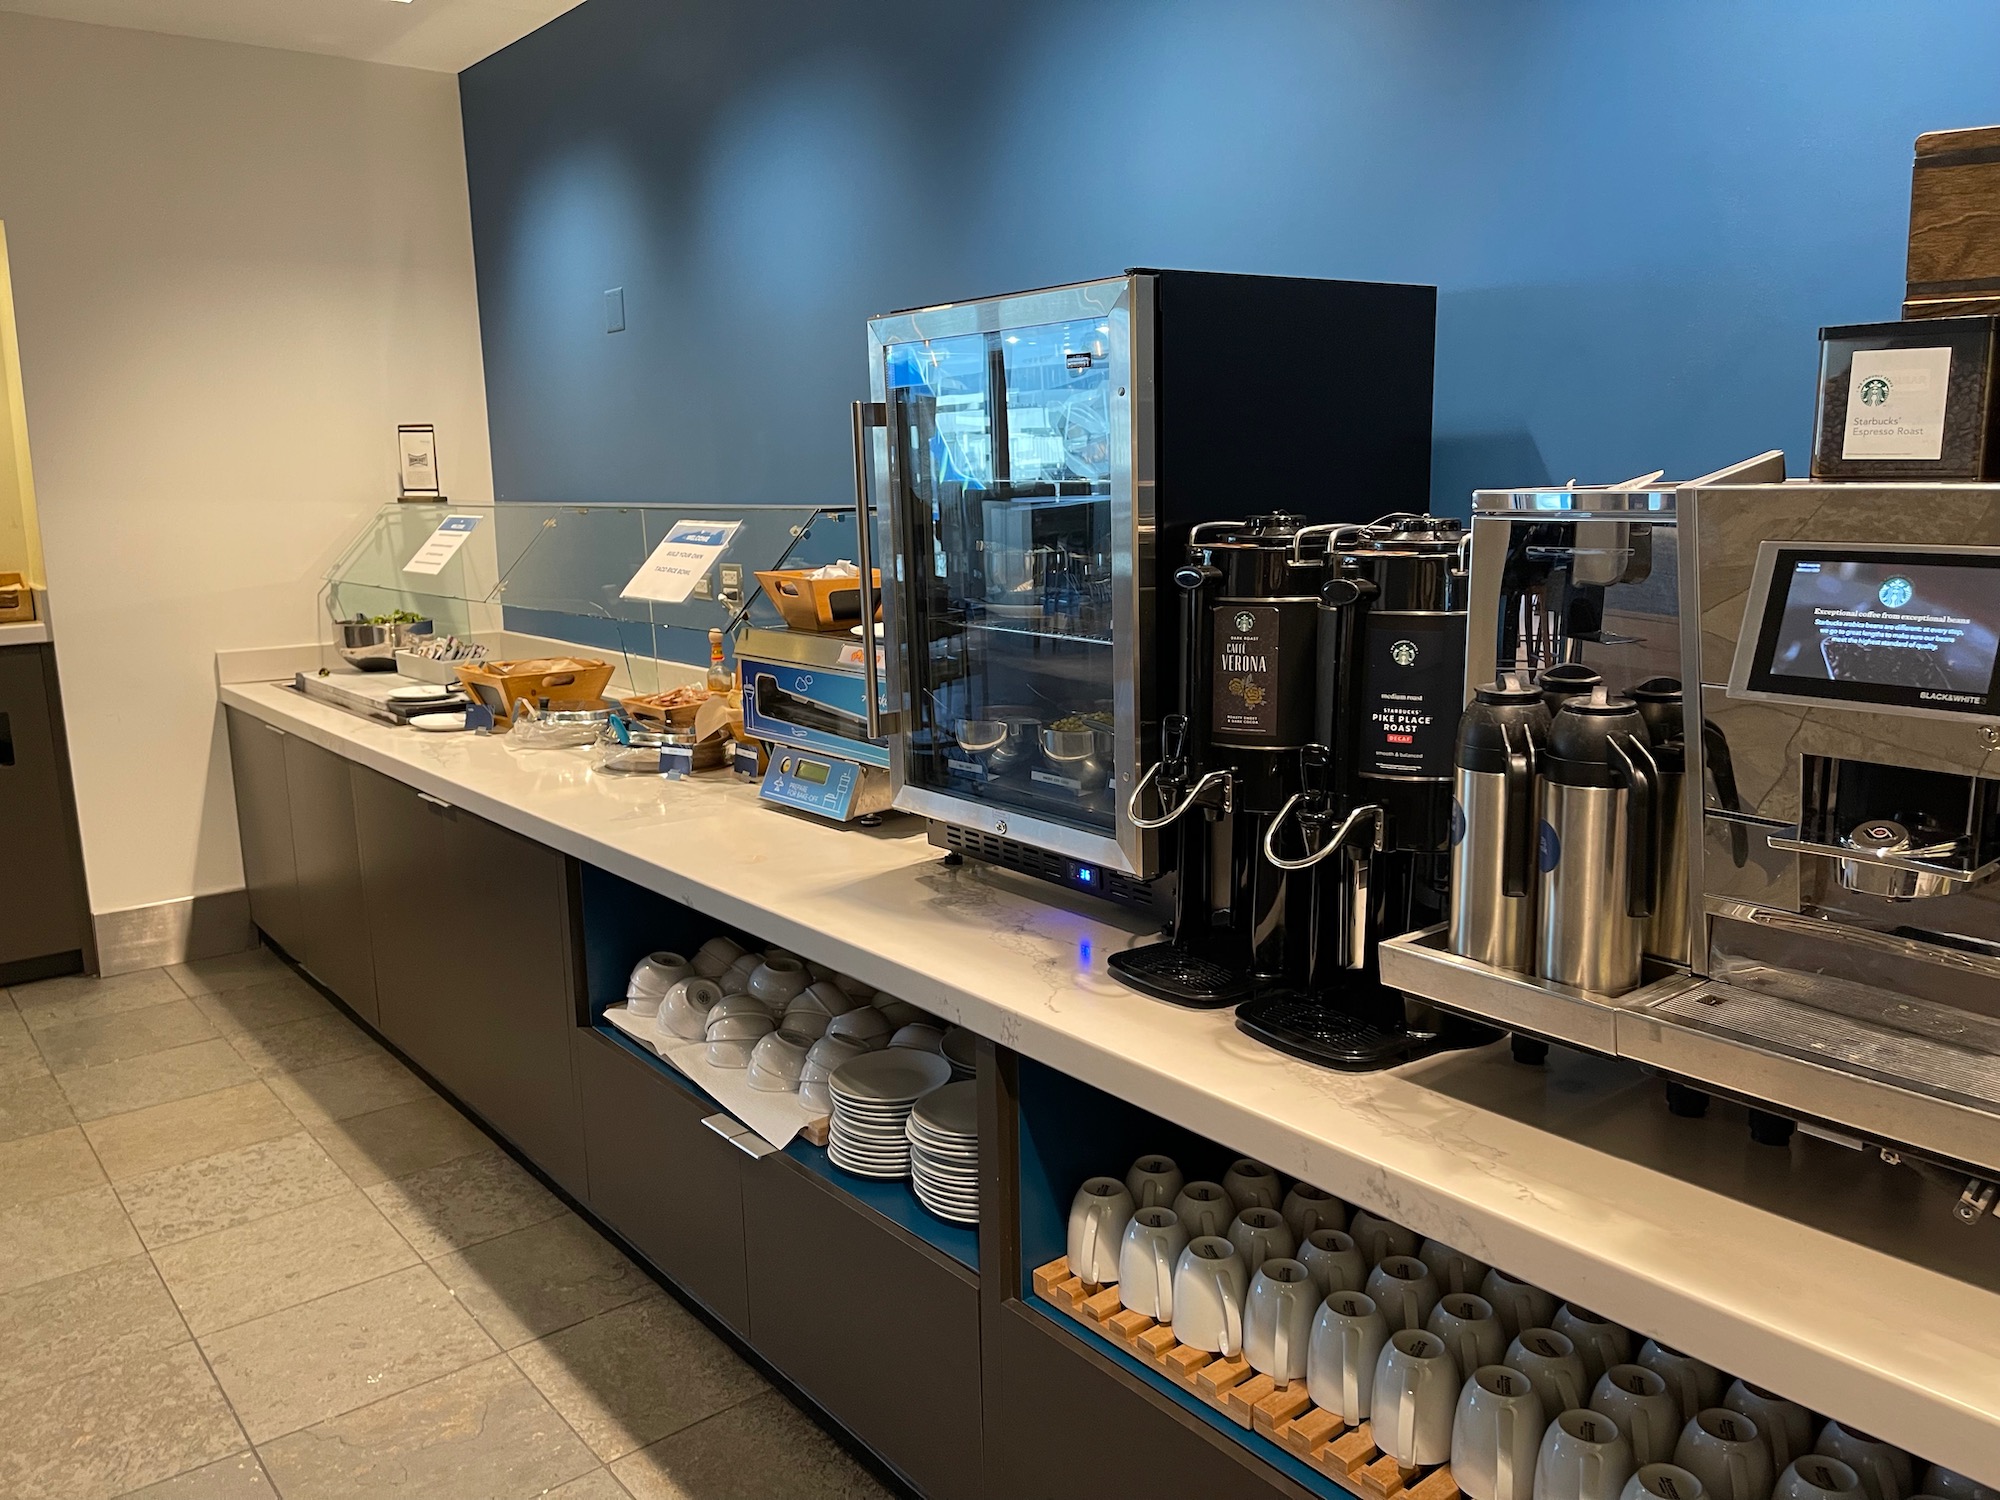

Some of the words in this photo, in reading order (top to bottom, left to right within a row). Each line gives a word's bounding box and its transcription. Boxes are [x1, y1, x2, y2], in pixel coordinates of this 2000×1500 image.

[1852, 427, 1895, 438] Espresso
[1897, 427, 1924, 436] Roast
[1814, 607, 1858, 617] Exceptional
[1858, 611, 1881, 619] coffee
[1881, 612, 1900, 620] from
[1901, 613, 1946, 623] exceptional
[1947, 616, 1971, 625] beans
[1221, 653, 1267, 673] VERONA
[1380, 693, 1407, 701] medium
[1406, 694, 1423, 702] roast
[1372, 714, 1395, 723] PIKE
[1398, 716, 1431, 724] PLACE
[1383, 724, 1418, 733] ROAST
[786, 789, 797, 797] FOR
[796, 791, 819, 802] BAKE-OFF
